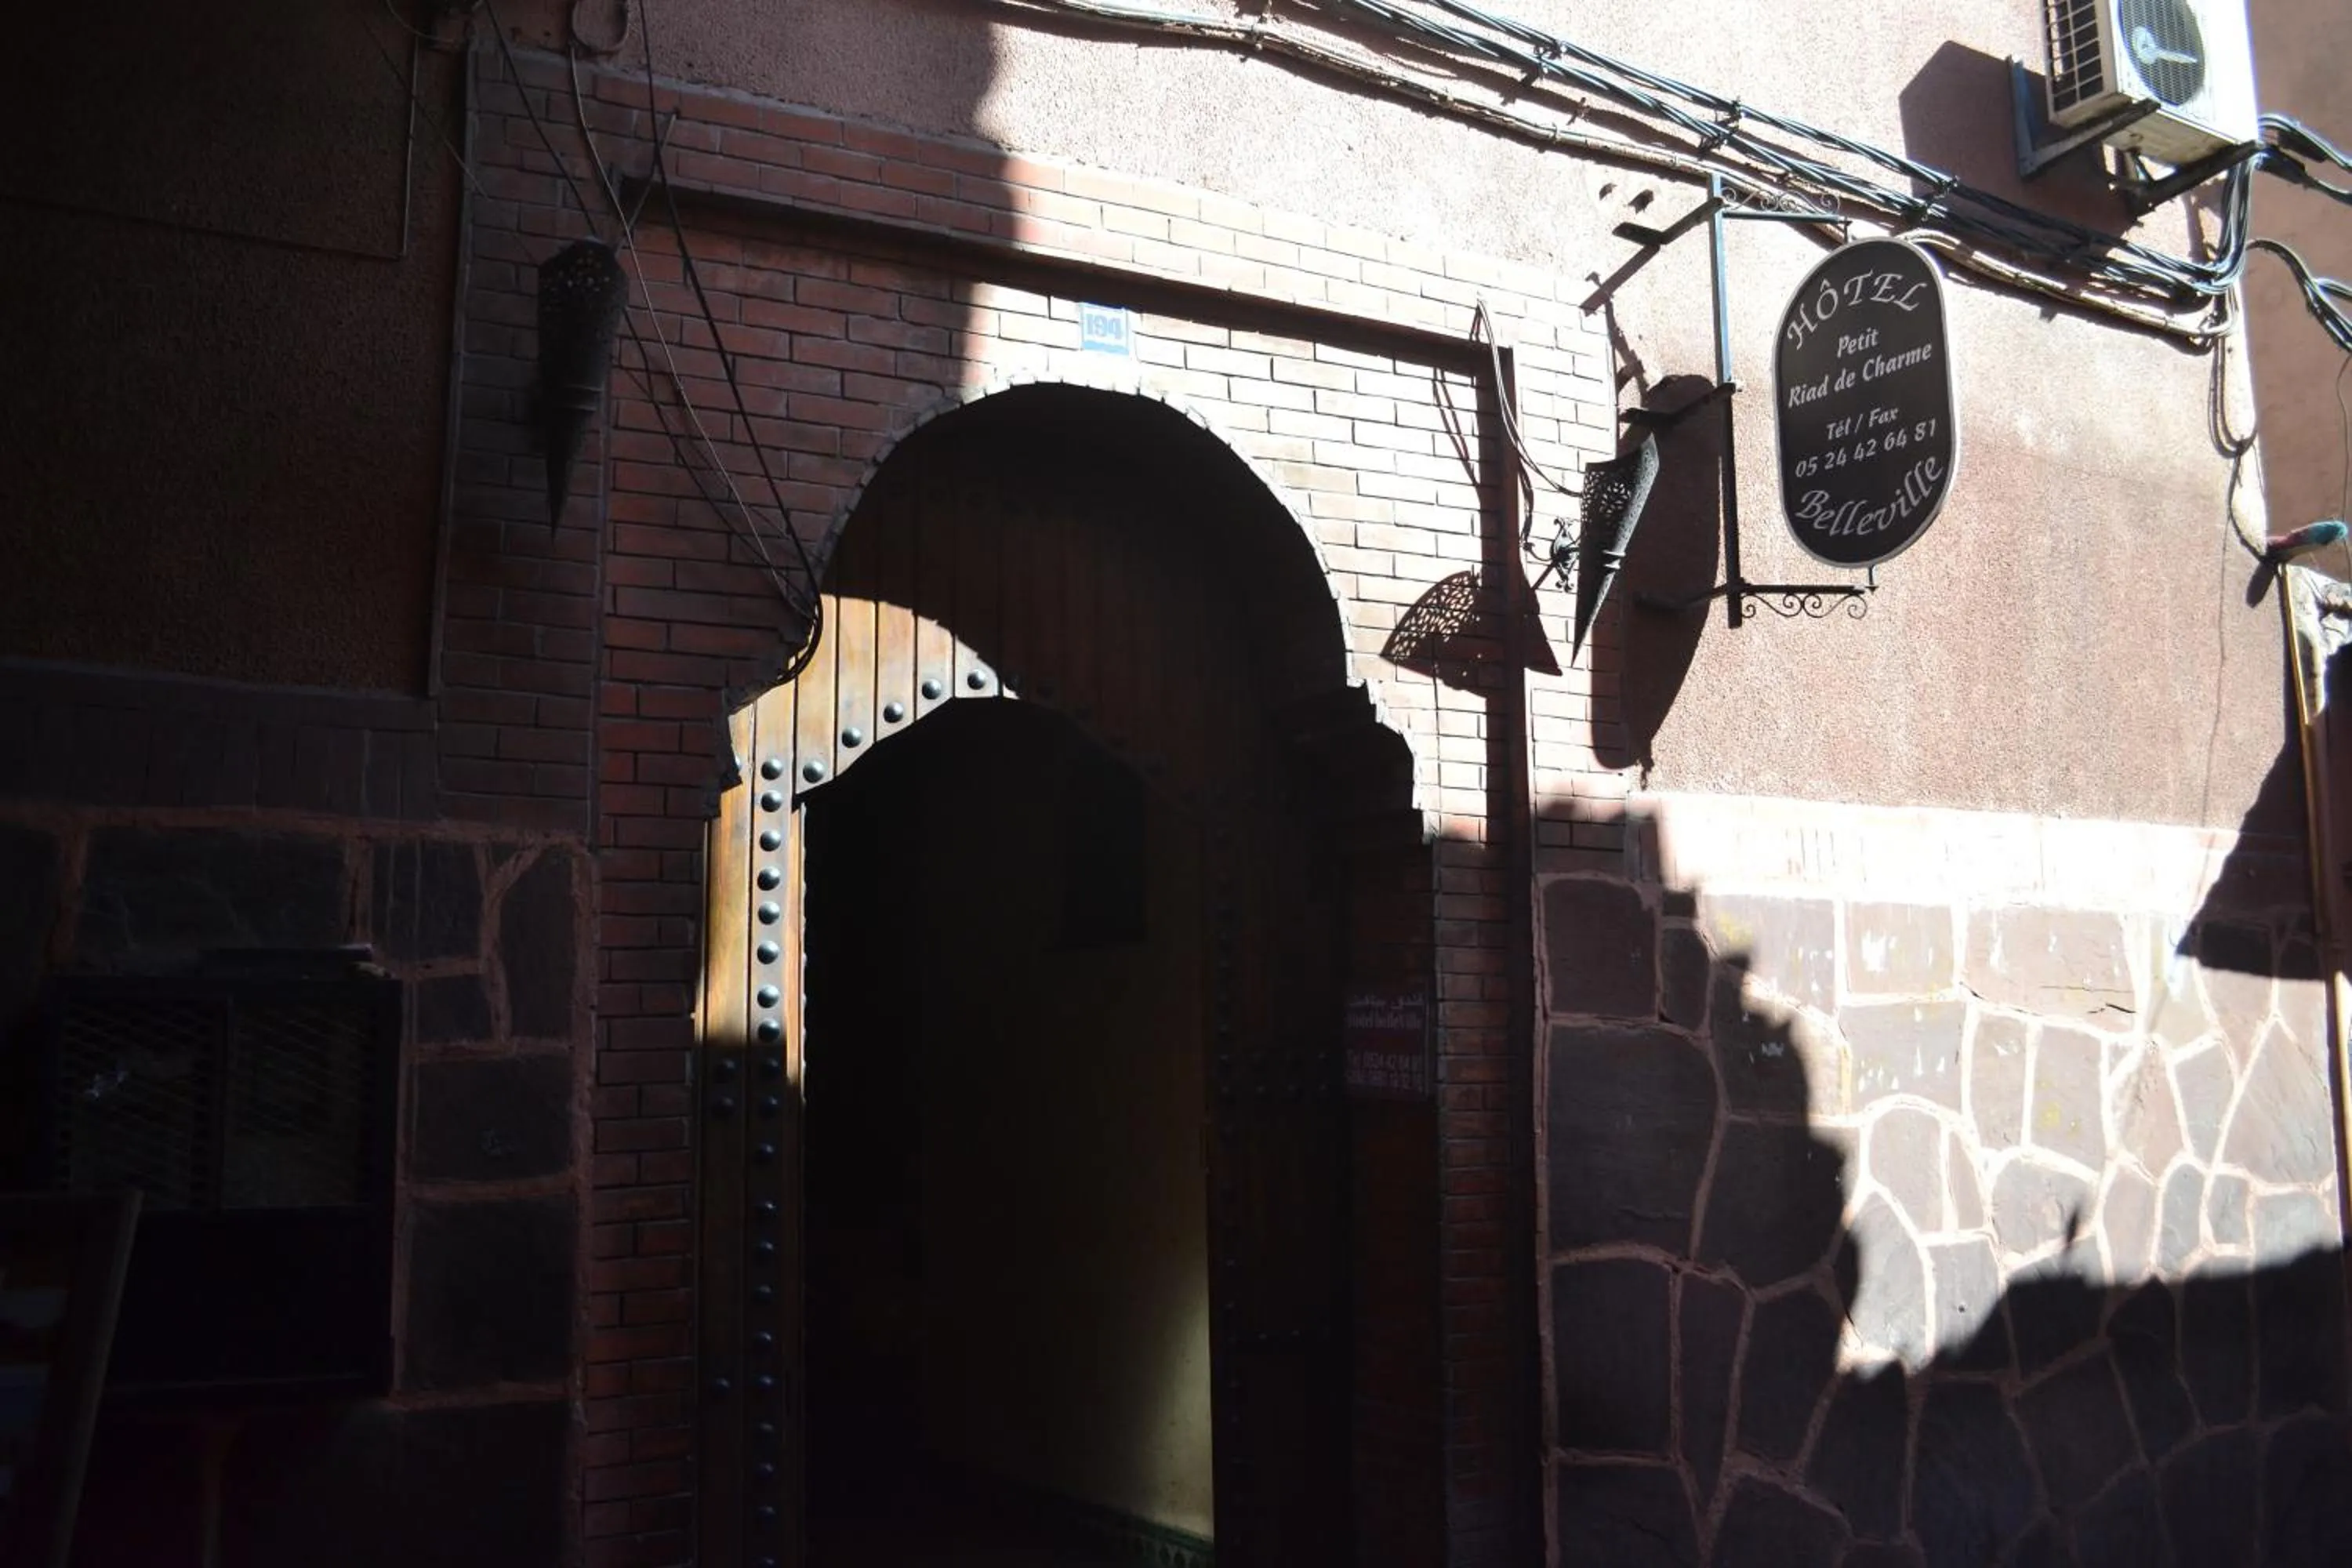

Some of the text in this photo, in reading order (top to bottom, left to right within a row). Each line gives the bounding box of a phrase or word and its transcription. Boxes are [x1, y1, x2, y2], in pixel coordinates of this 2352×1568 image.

[1787, 270, 1928, 350] HÔTEL
[1837, 327, 1879, 358] Petit
[1788, 343, 1933, 408] Riad de Charme
[1795, 418, 1936, 477] 05 24 42 64 81
[1826, 407, 1900, 441] Tél / Fax
[1794, 456, 1944, 537] Belleville
